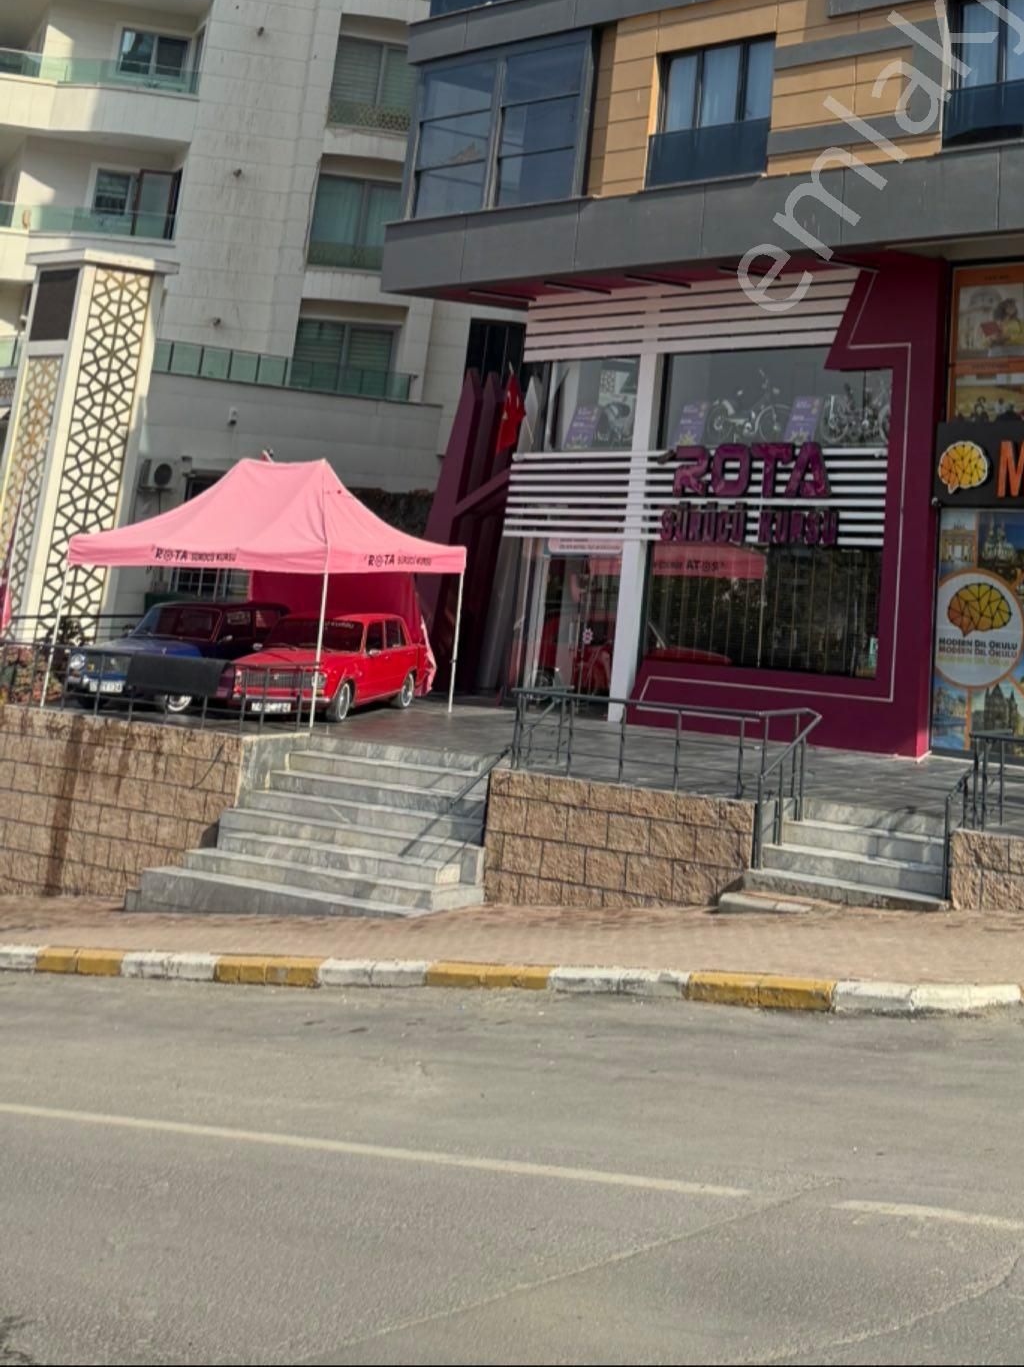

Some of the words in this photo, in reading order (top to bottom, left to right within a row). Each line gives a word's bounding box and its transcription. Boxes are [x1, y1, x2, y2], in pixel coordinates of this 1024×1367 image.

[672, 442, 832, 498] ROTA
[660, 501, 747, 543] SÜRÜCÜ
[758, 505, 839, 545] KURSU
